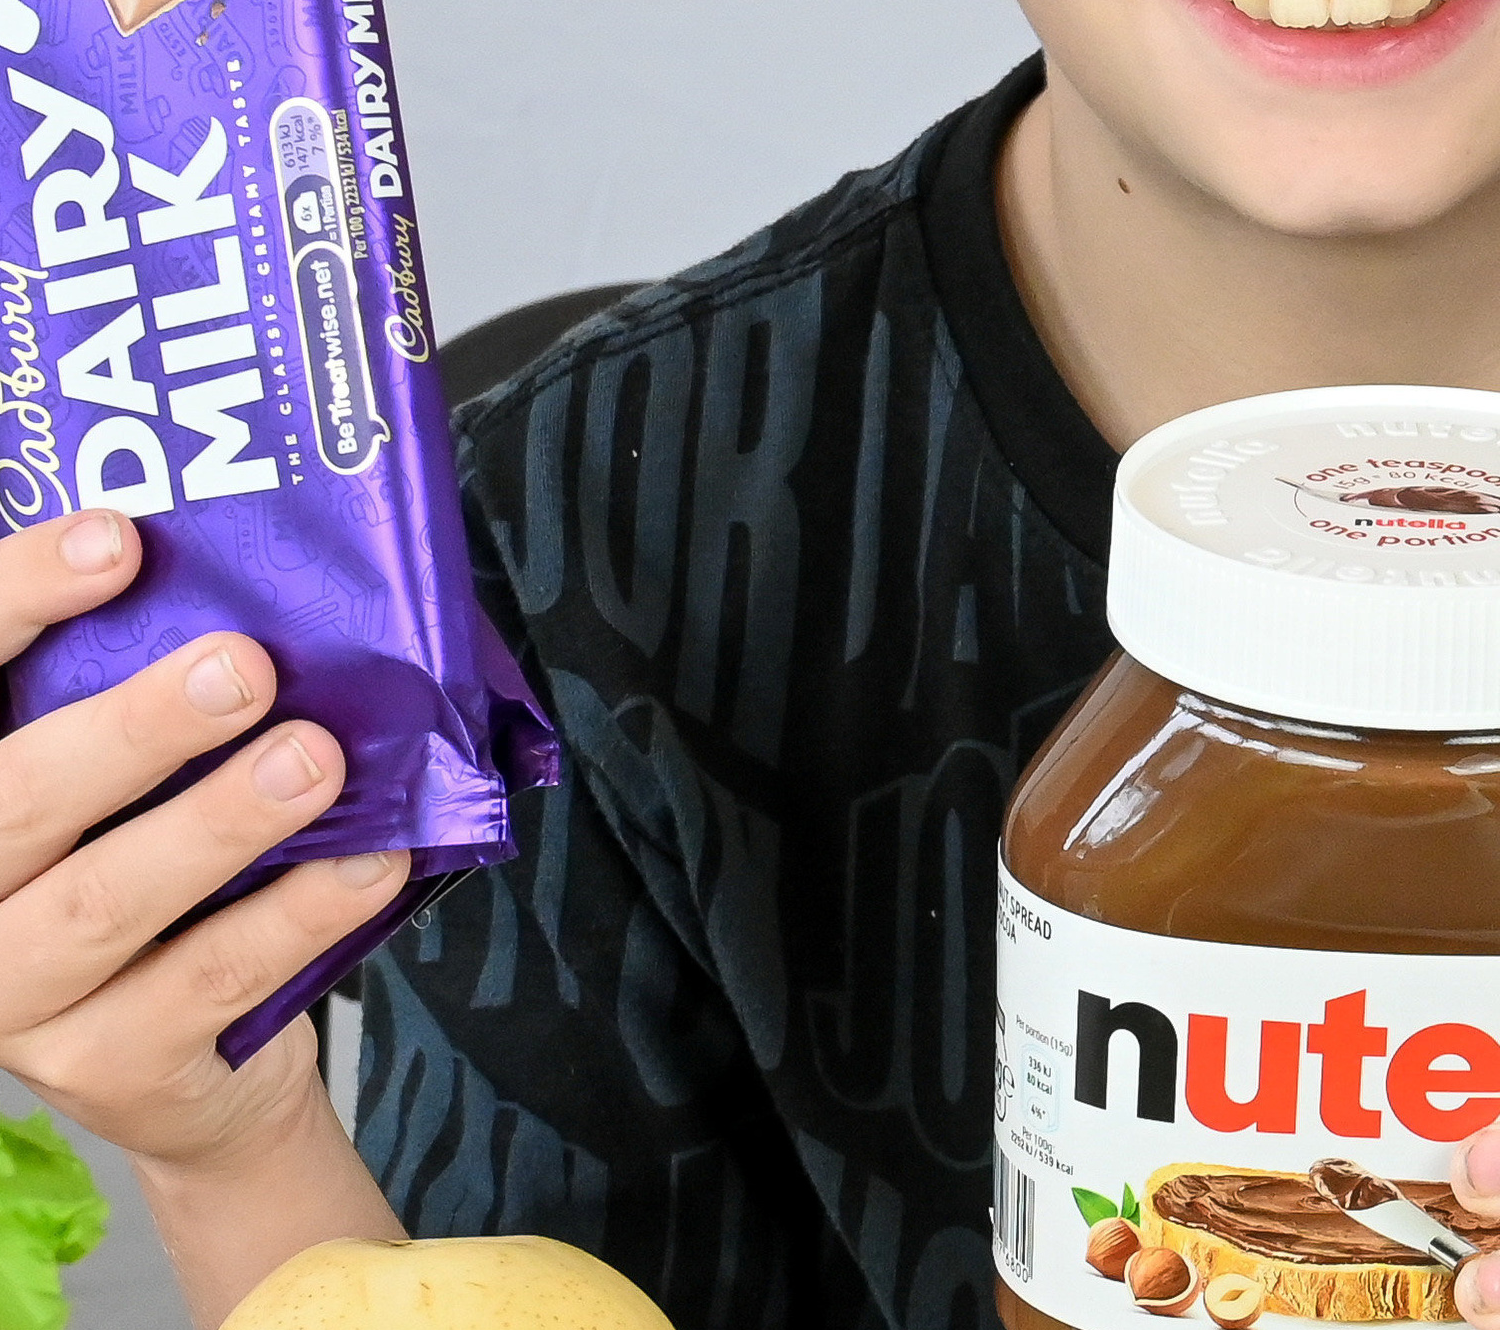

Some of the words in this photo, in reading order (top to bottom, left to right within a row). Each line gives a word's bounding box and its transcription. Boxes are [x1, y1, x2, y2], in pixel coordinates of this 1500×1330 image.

[117, 43, 139, 115] MILK
[227, 59, 251, 147] TASTE
[279, 124, 291, 141] kJ
[291, 114, 306, 146] kcal
[331, 109, 349, 134] kcal
[350, 48, 403, 198] DAIRY
[281, 142, 296, 168] 613
[296, 147, 310, 171] 147
[300, 205, 313, 222] 6x
[320, 185, 337, 224] Portion
[242, 165, 271, 276] CREAMY
[353, 239, 369, 260] Per
[7, 67, 175, 518] DAIRY
[384, 213, 430, 363] Cadbury
[127, 117, 280, 501] MILK
[262, 293, 293, 415] CLASSIC
[285, 433, 304, 485] THE
[1305, 463, 1359, 483] one
[1389, 471, 1416, 479] 80
[1425, 473, 1479, 489] kcal
[1309, 520, 1368, 540] one
[1354, 518, 1467, 531] nutella
[1010, 896, 1052, 940] SPREAD
[1016, 1014, 1024, 1030] Per
[1025, 1024, 1049, 1046] portion
[1050, 1036, 1073, 1057] (15g)
[1037, 1078, 1052, 1095] kcal
[1022, 1126, 1032, 1140] Per
[1039, 1150, 1054, 1167] 539
[1056, 1159, 1073, 1175] kcal
